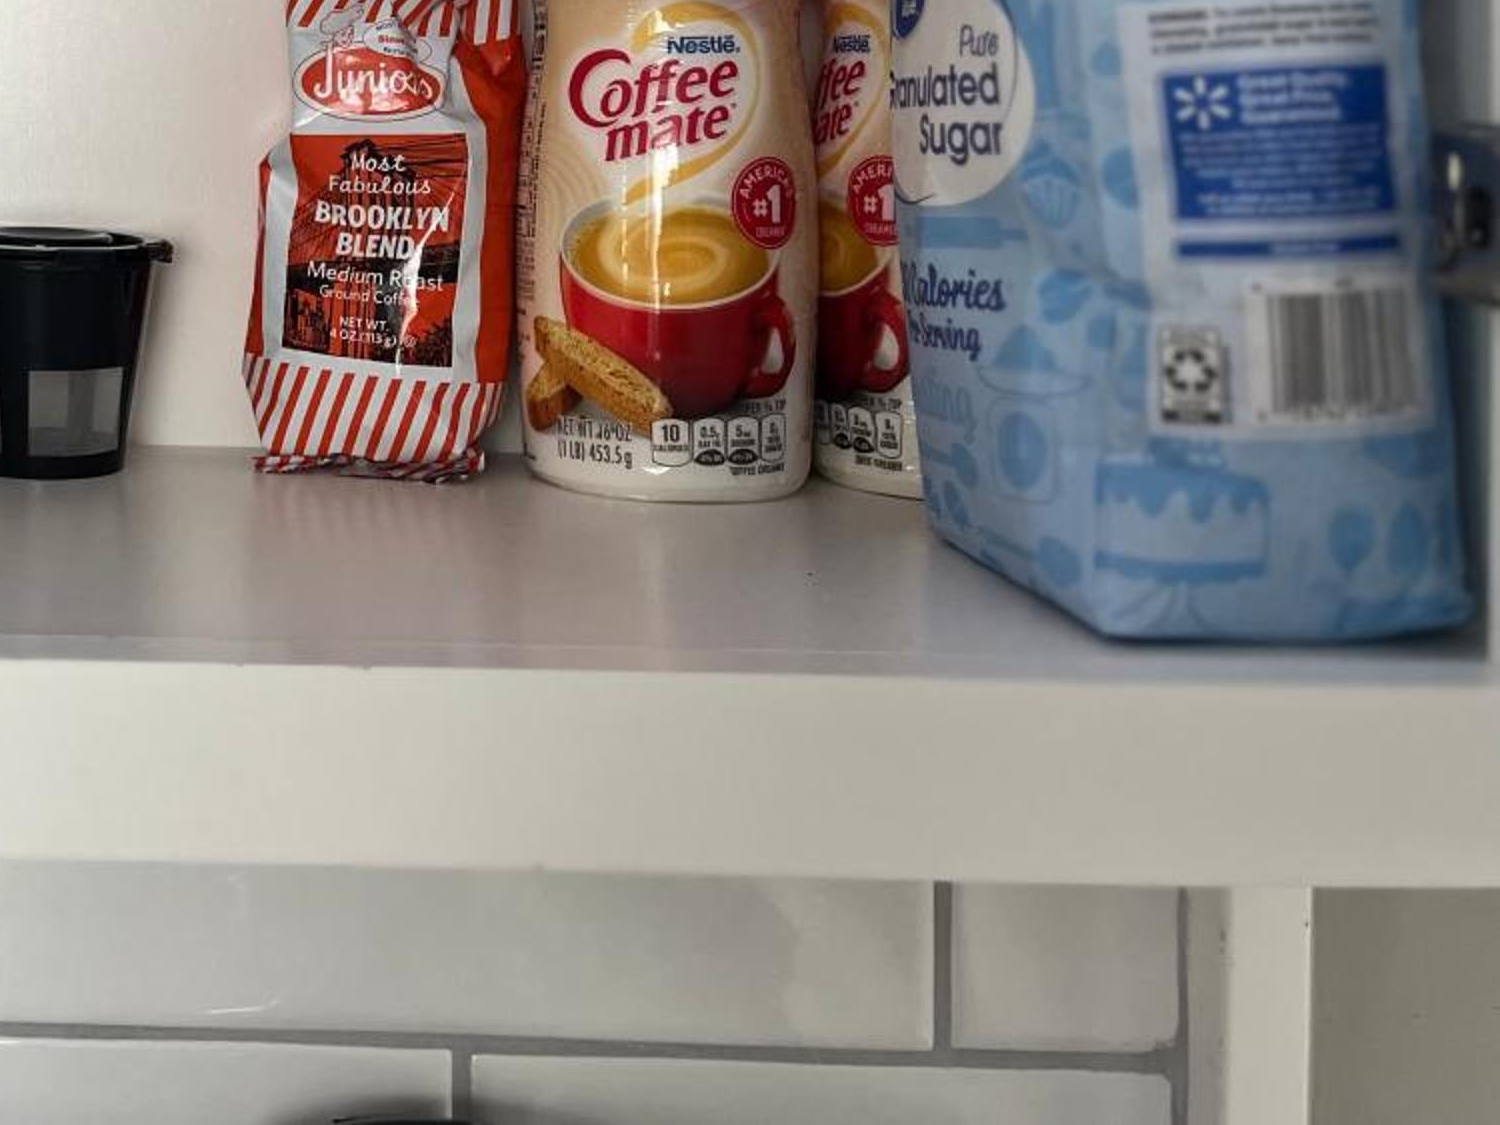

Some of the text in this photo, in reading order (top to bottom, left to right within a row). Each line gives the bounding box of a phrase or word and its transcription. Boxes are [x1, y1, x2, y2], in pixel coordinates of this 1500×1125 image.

[959, 24, 999, 56] Pure
[569, 48, 739, 128] Coffee
[605, 106, 730, 162] mate
[919, 113, 1002, 166] Sugar
[351, 151, 406, 172] Most
[329, 174, 432, 194] Fabulous
[314, 198, 451, 233] BROOKLYN
[753, 184, 781, 225] #1
[335, 231, 417, 260] BLEND
[307, 259, 384, 287] Medium
[319, 284, 370, 303] Ground
[340, 315, 363, 329] NET
[661, 423, 680, 443] 10
